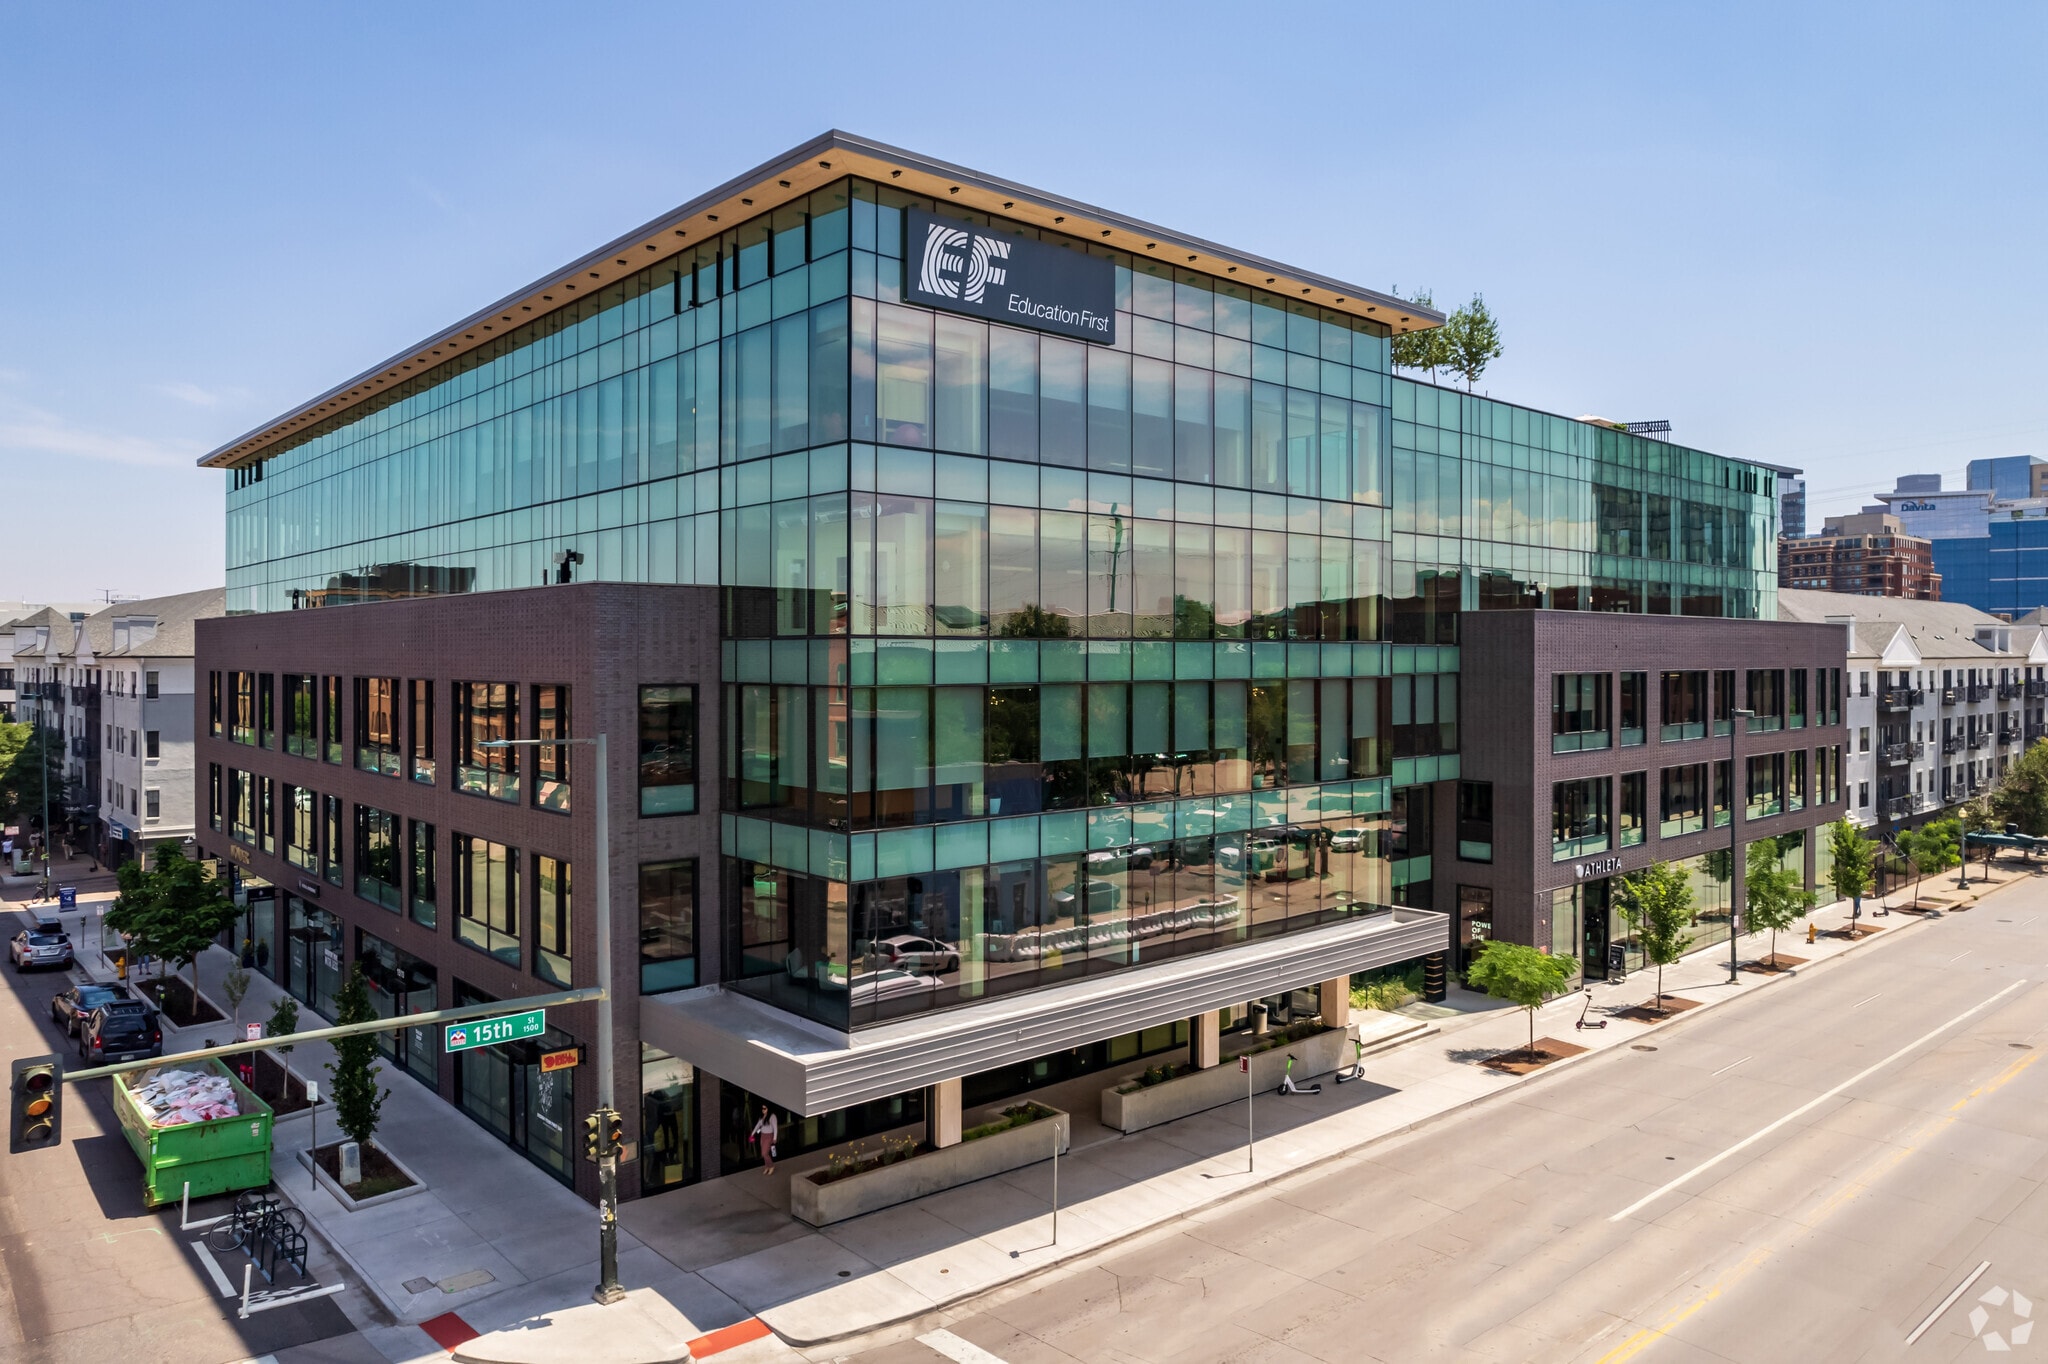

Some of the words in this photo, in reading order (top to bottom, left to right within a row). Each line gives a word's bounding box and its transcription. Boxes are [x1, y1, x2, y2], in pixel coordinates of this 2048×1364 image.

[1007, 293, 1079, 326] Education
[1080, 310, 1109, 332] First
[1901, 501, 1936, 511] DaVita
[1584, 857, 1622, 877] ATHLETA
[1471, 933, 1485, 942] SHE
[527, 1016, 535, 1024] St
[473, 1020, 513, 1043] 15th
[523, 1023, 539, 1033] 1500
